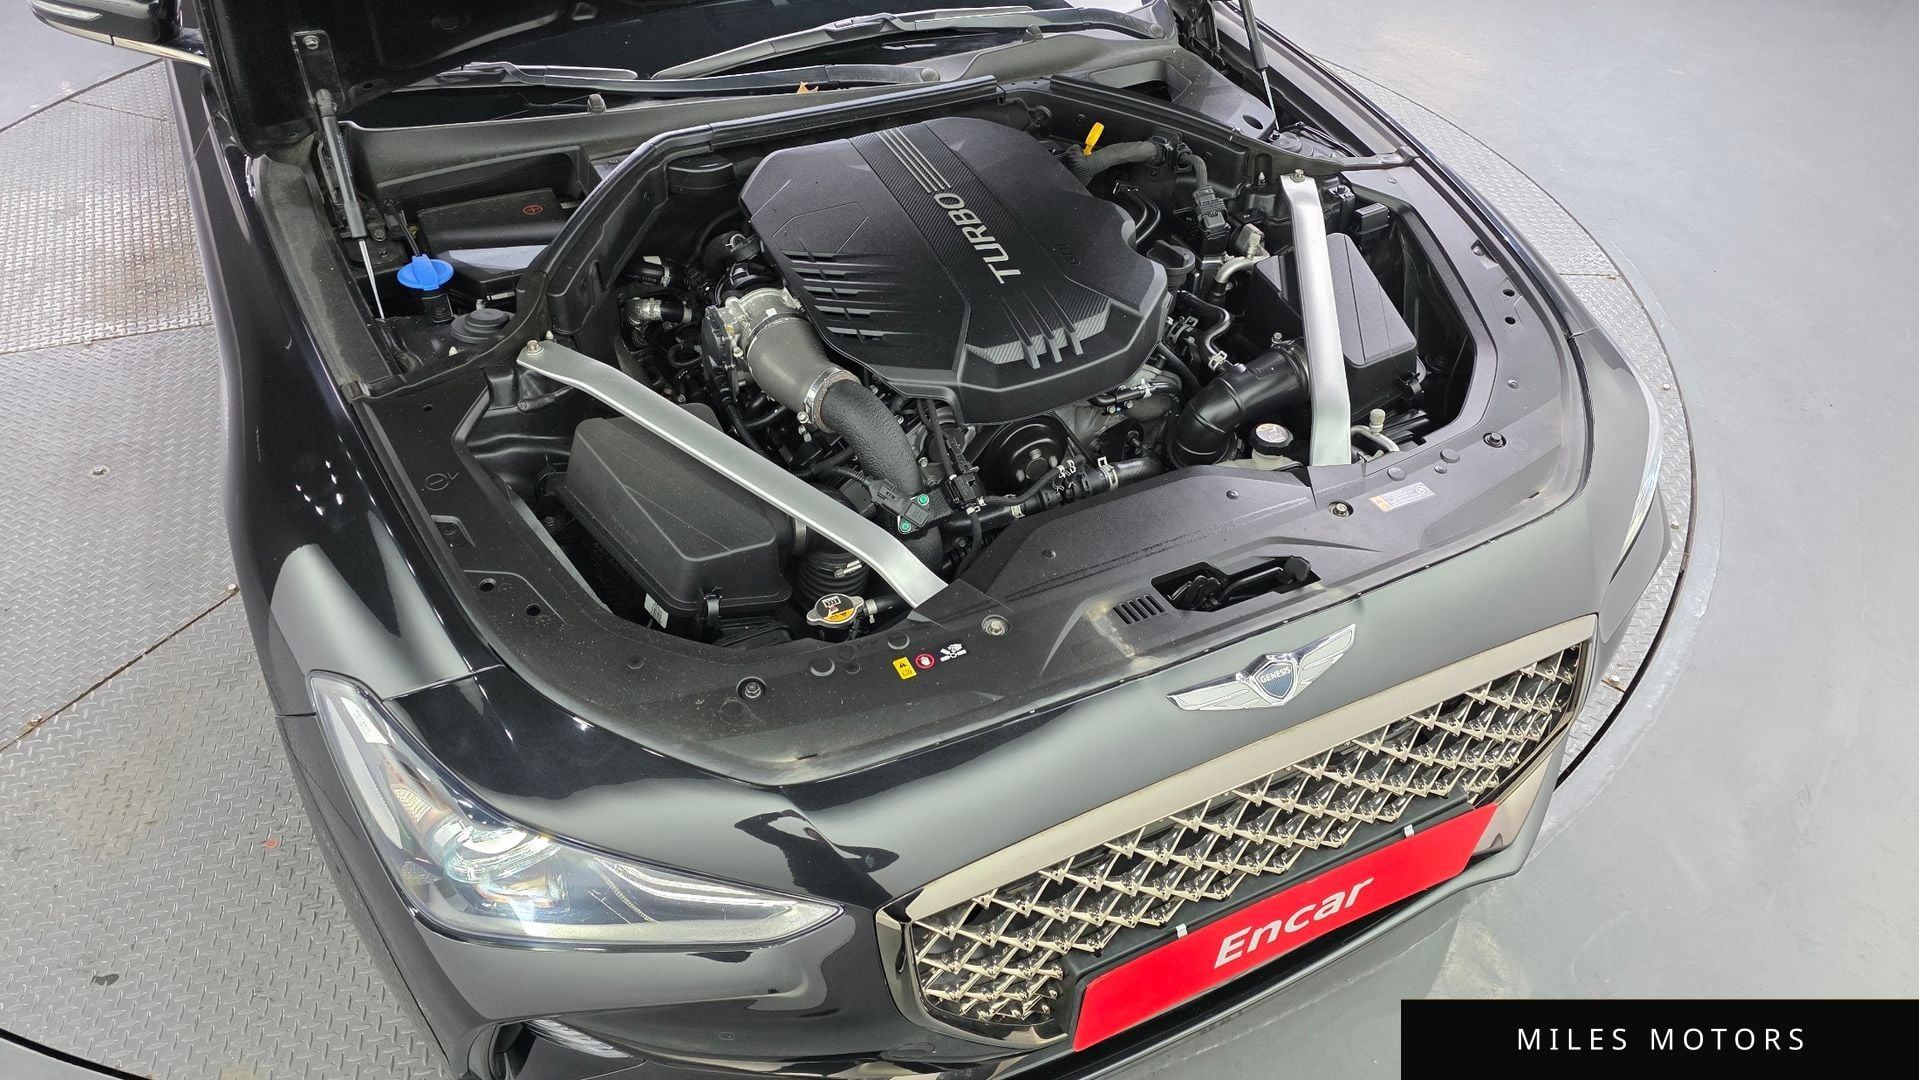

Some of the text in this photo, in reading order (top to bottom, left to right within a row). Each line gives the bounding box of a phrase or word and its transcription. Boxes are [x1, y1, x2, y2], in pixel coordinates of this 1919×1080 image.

[934, 192, 1021, 284] TURBO
[1260, 666, 1291, 683] GENESIS
[1213, 877, 1374, 969] Encar
